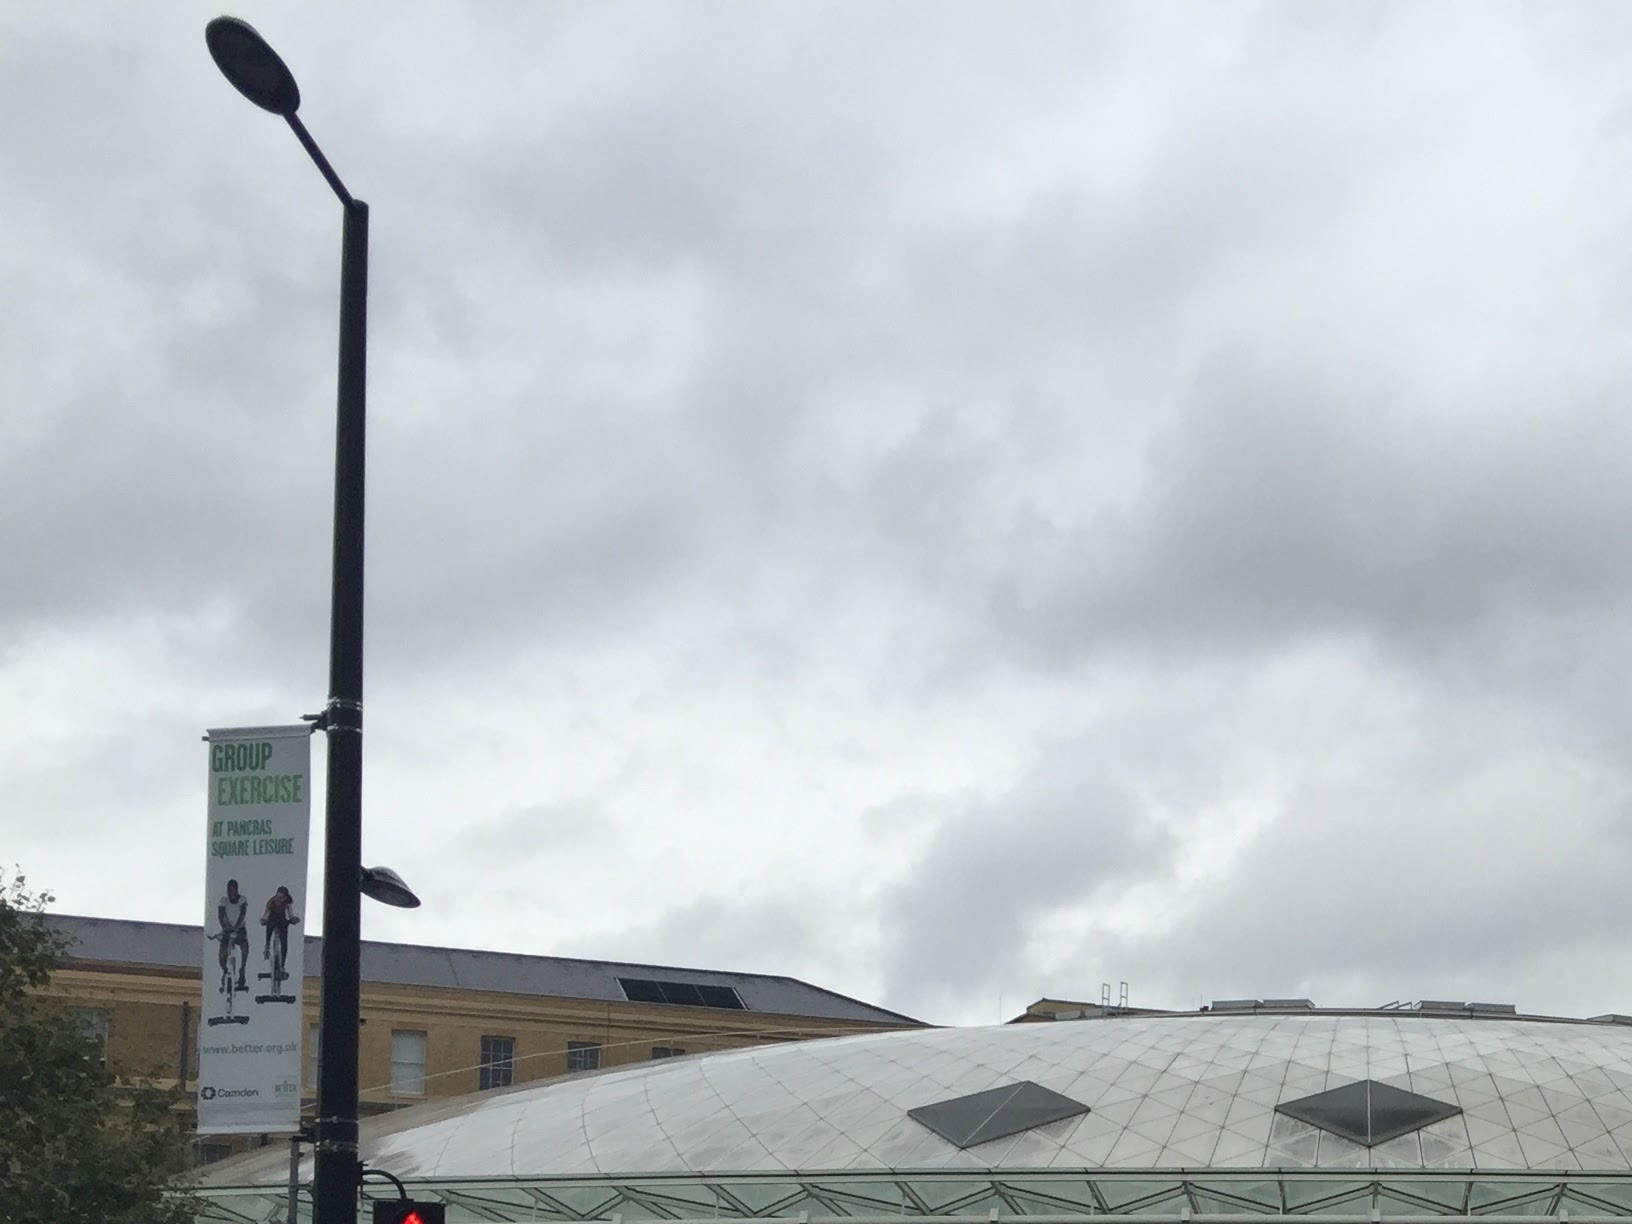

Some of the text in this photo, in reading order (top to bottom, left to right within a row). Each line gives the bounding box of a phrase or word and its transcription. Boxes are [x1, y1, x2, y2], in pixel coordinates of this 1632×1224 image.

[211, 741, 273, 773] GROUP
[217, 773, 304, 807] EXERCISE
[211, 818, 273, 838] AT PANCRAS
[210, 837, 295, 860] SQUARE LEISURE
[202, 1041, 298, 1055] www.better.org.uk
[217, 1087, 259, 1098] Camden
